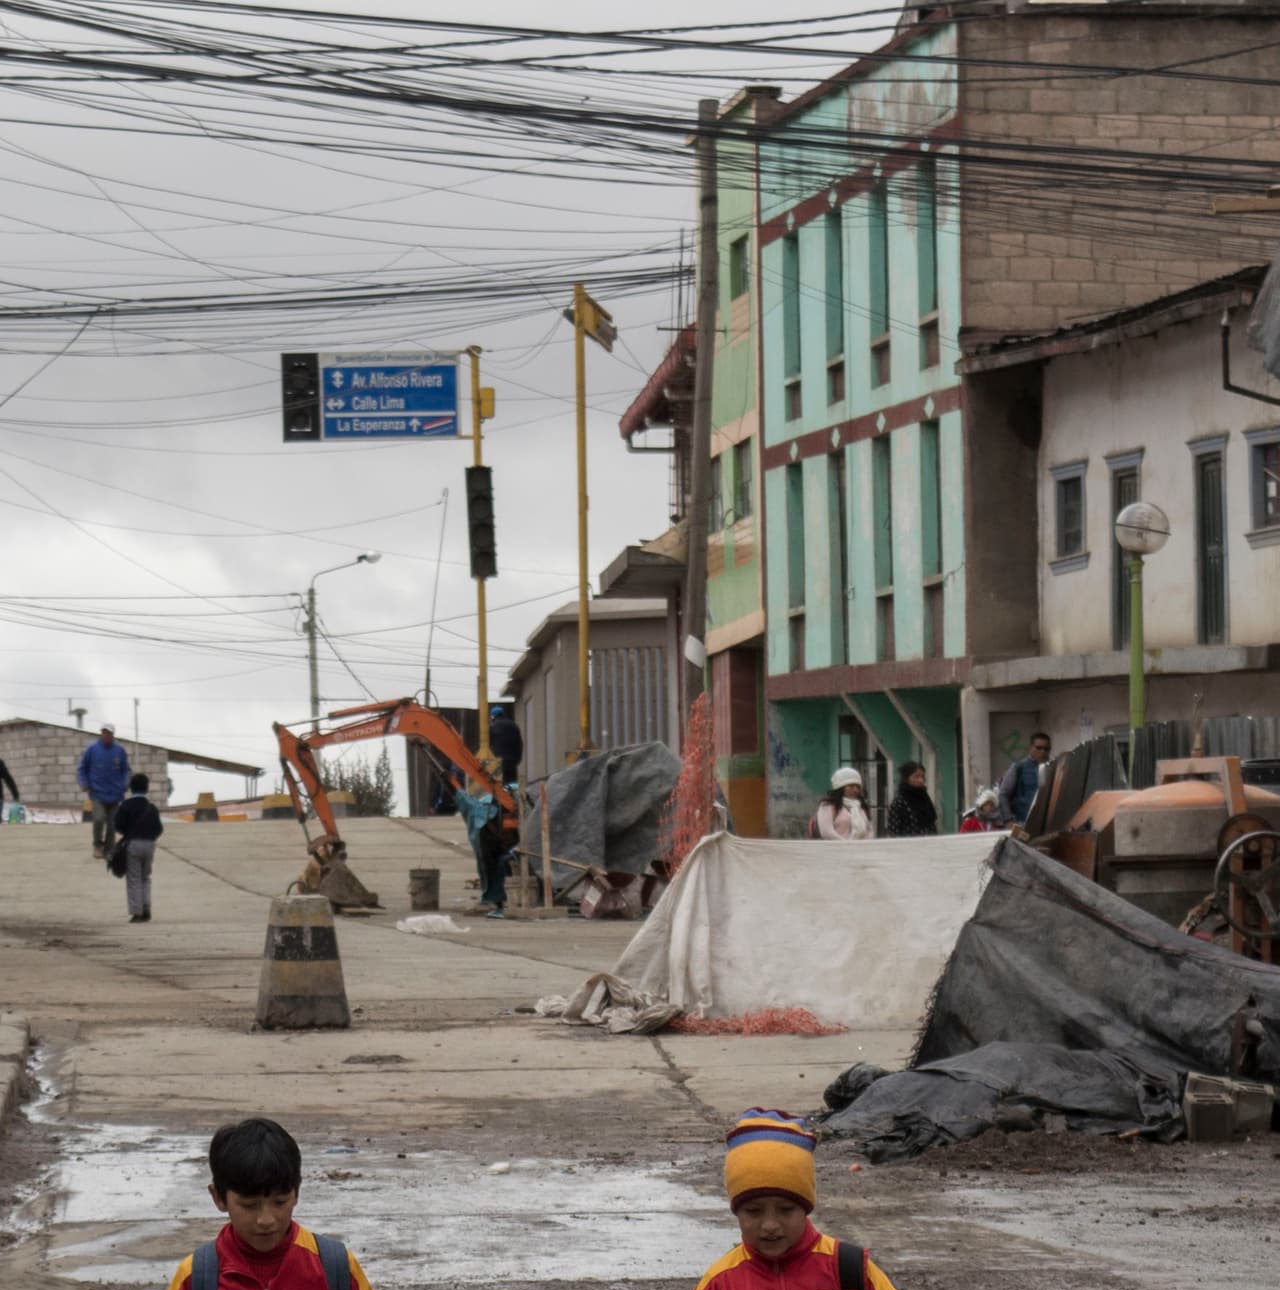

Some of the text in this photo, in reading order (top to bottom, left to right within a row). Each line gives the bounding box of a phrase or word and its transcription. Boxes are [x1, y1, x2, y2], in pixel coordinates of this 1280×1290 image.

[352, 372, 442, 388] Av. Alfonso Rivera
[352, 396, 405, 411] Calle Lima
[337, 420, 350, 433] La
[352, 418, 407, 434] Esperanza
